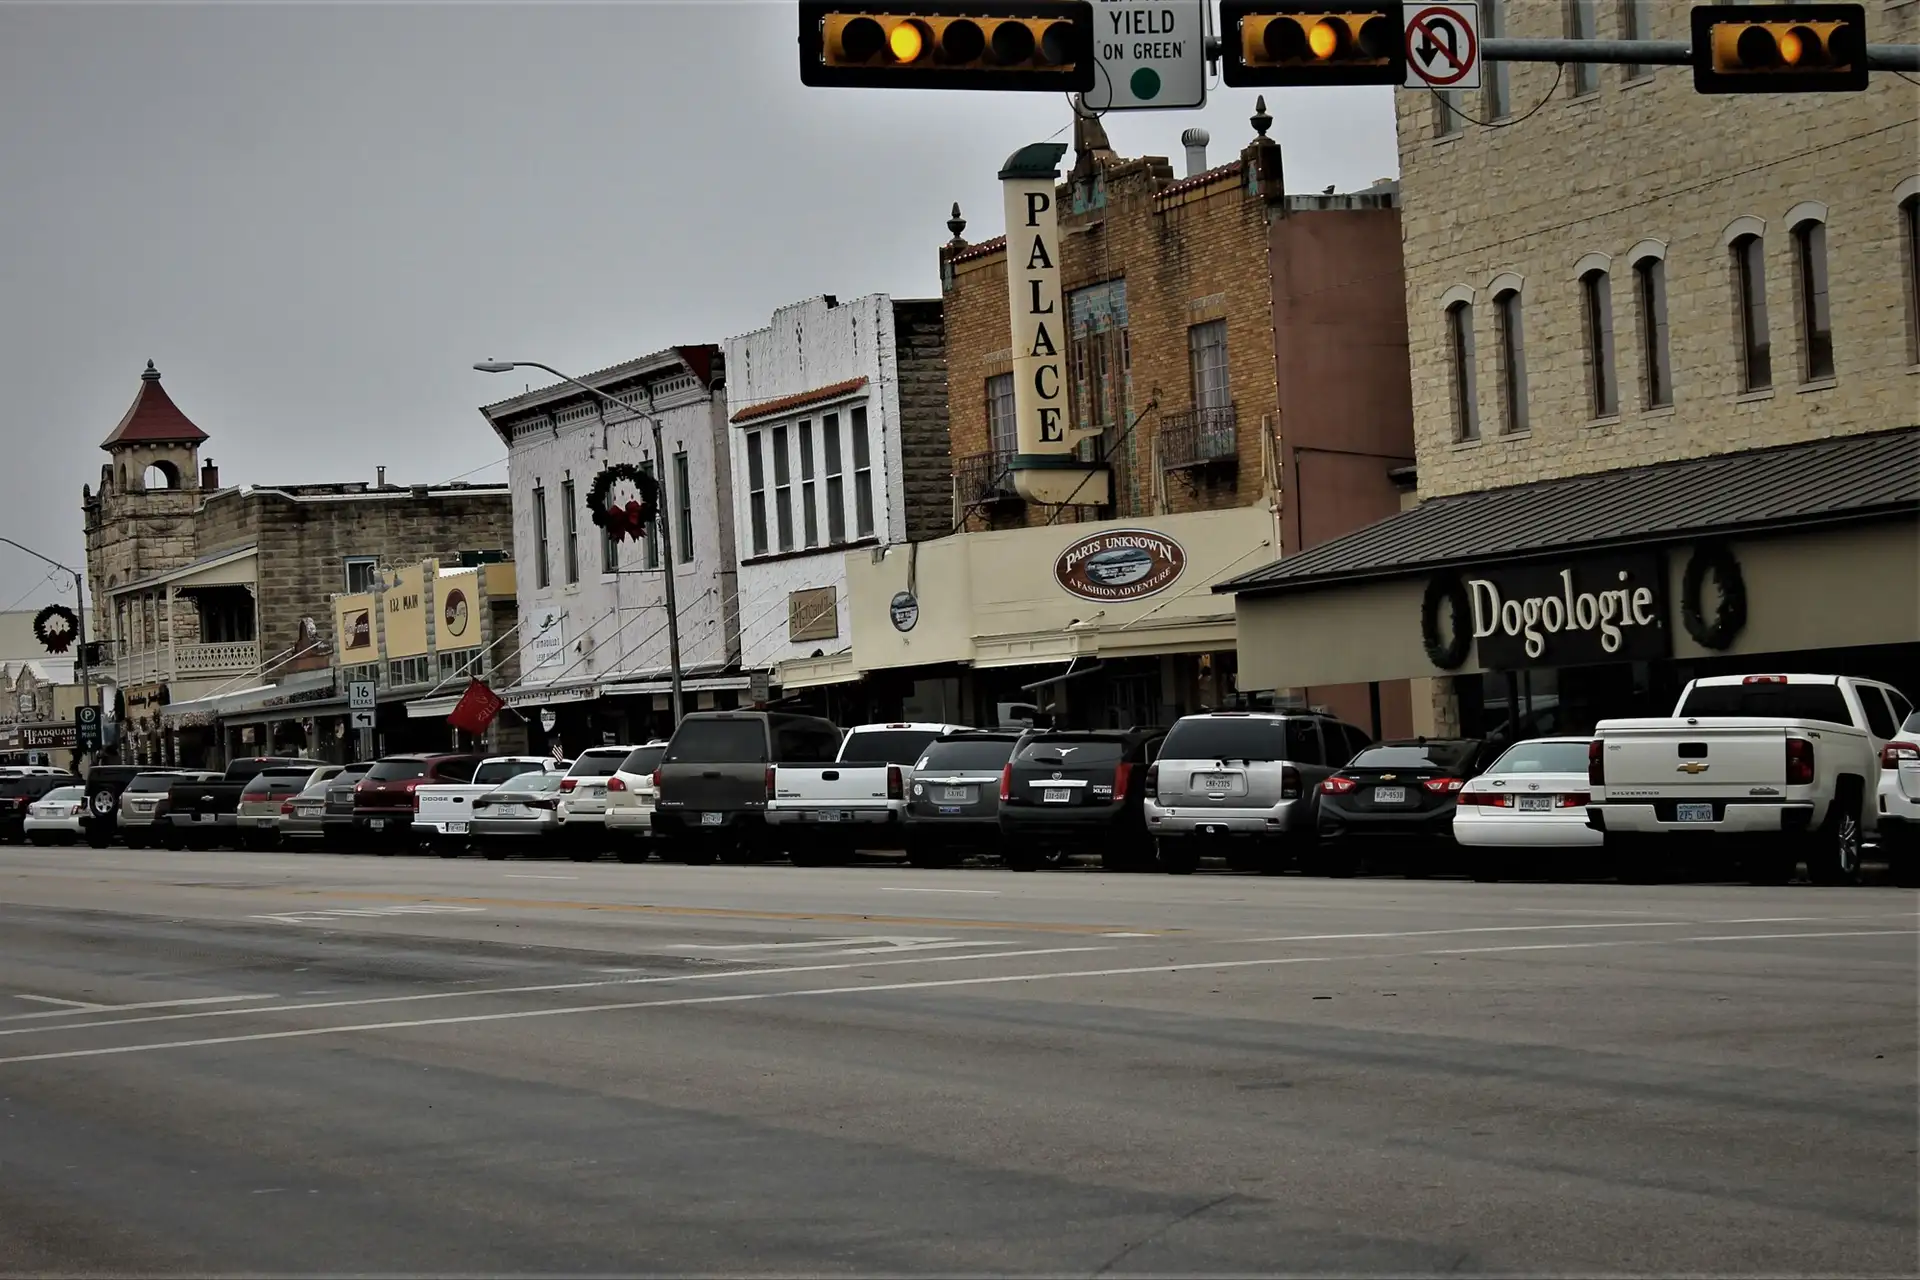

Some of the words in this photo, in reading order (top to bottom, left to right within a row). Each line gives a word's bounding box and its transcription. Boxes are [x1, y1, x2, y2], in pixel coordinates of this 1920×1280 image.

[1109, 9, 1175, 35] YIELD
[1103, 43, 1124, 60] ON
[1133, 42, 1182, 60] GREEN
[1023, 192, 1064, 443] PALACE
[1065, 540, 1101, 574] PARTS
[1105, 536, 1173, 564] UNKNOWN
[1069, 577, 1076, 587] A
[1077, 582, 1117, 596] FASHION
[1118, 567, 1171, 596] ADVENTURE
[402, 594, 419, 611] MAIN
[1468, 568, 1655, 658] Dogologie
[356, 686, 369, 698] 16
[353, 698, 373, 706] TEXAS
[81, 723, 97, 731] West
[28, 736, 53, 745] HATS
[1679, 810, 1693, 820] 275
